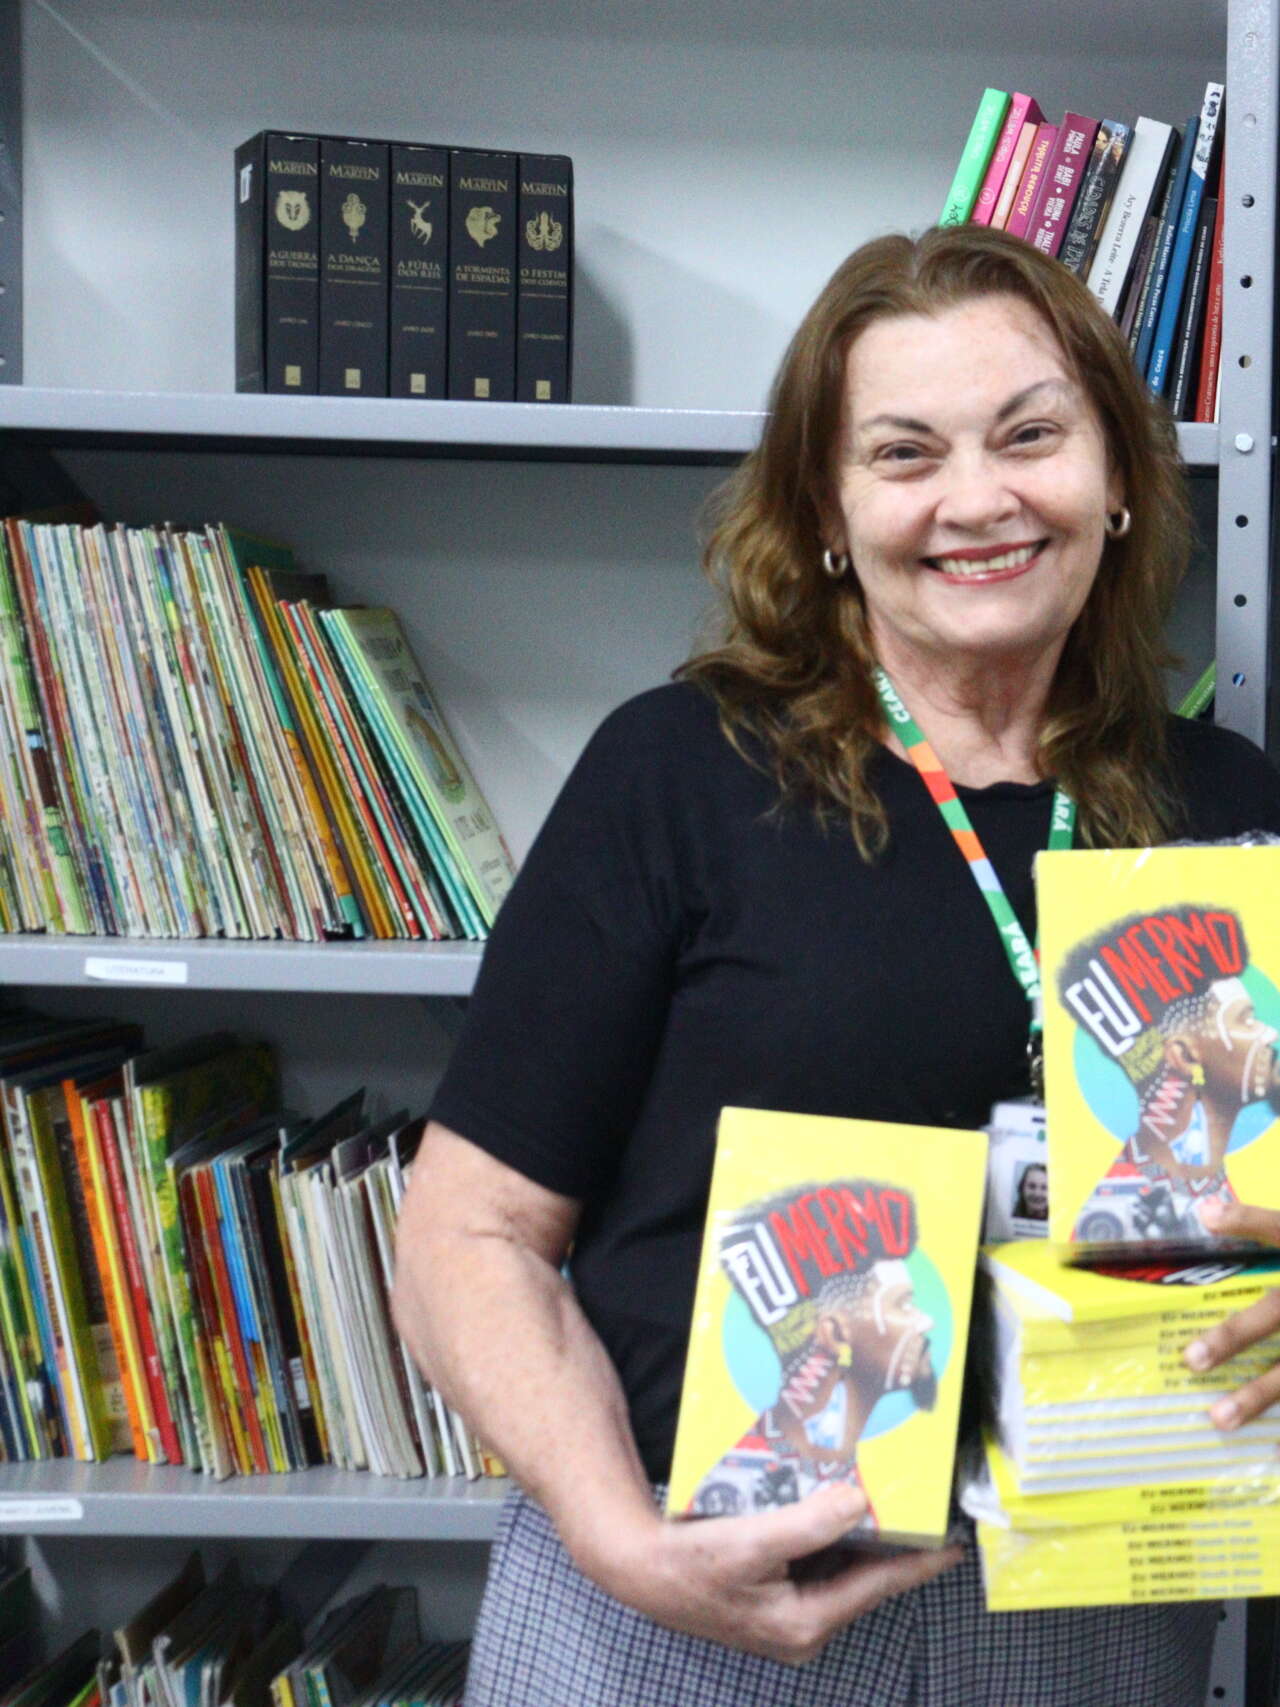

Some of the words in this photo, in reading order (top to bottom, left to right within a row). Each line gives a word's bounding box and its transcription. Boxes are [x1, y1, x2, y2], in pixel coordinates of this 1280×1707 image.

[269, 160, 318, 176] MARTIN
[329, 164, 379, 180] MARTIN
[396, 172, 444, 186] MARTIN
[459, 177, 509, 192] MARTIN
[521, 181, 568, 196] MARTIN
[876, 671, 911, 723] CEAR
[1053, 791, 1073, 832] ARÁ
[1100, 911, 1244, 1024] MERMO
[1065, 959, 1142, 1057] EU
[728, 1220, 799, 1326] EU
[768, 1185, 913, 1297] MERMO
